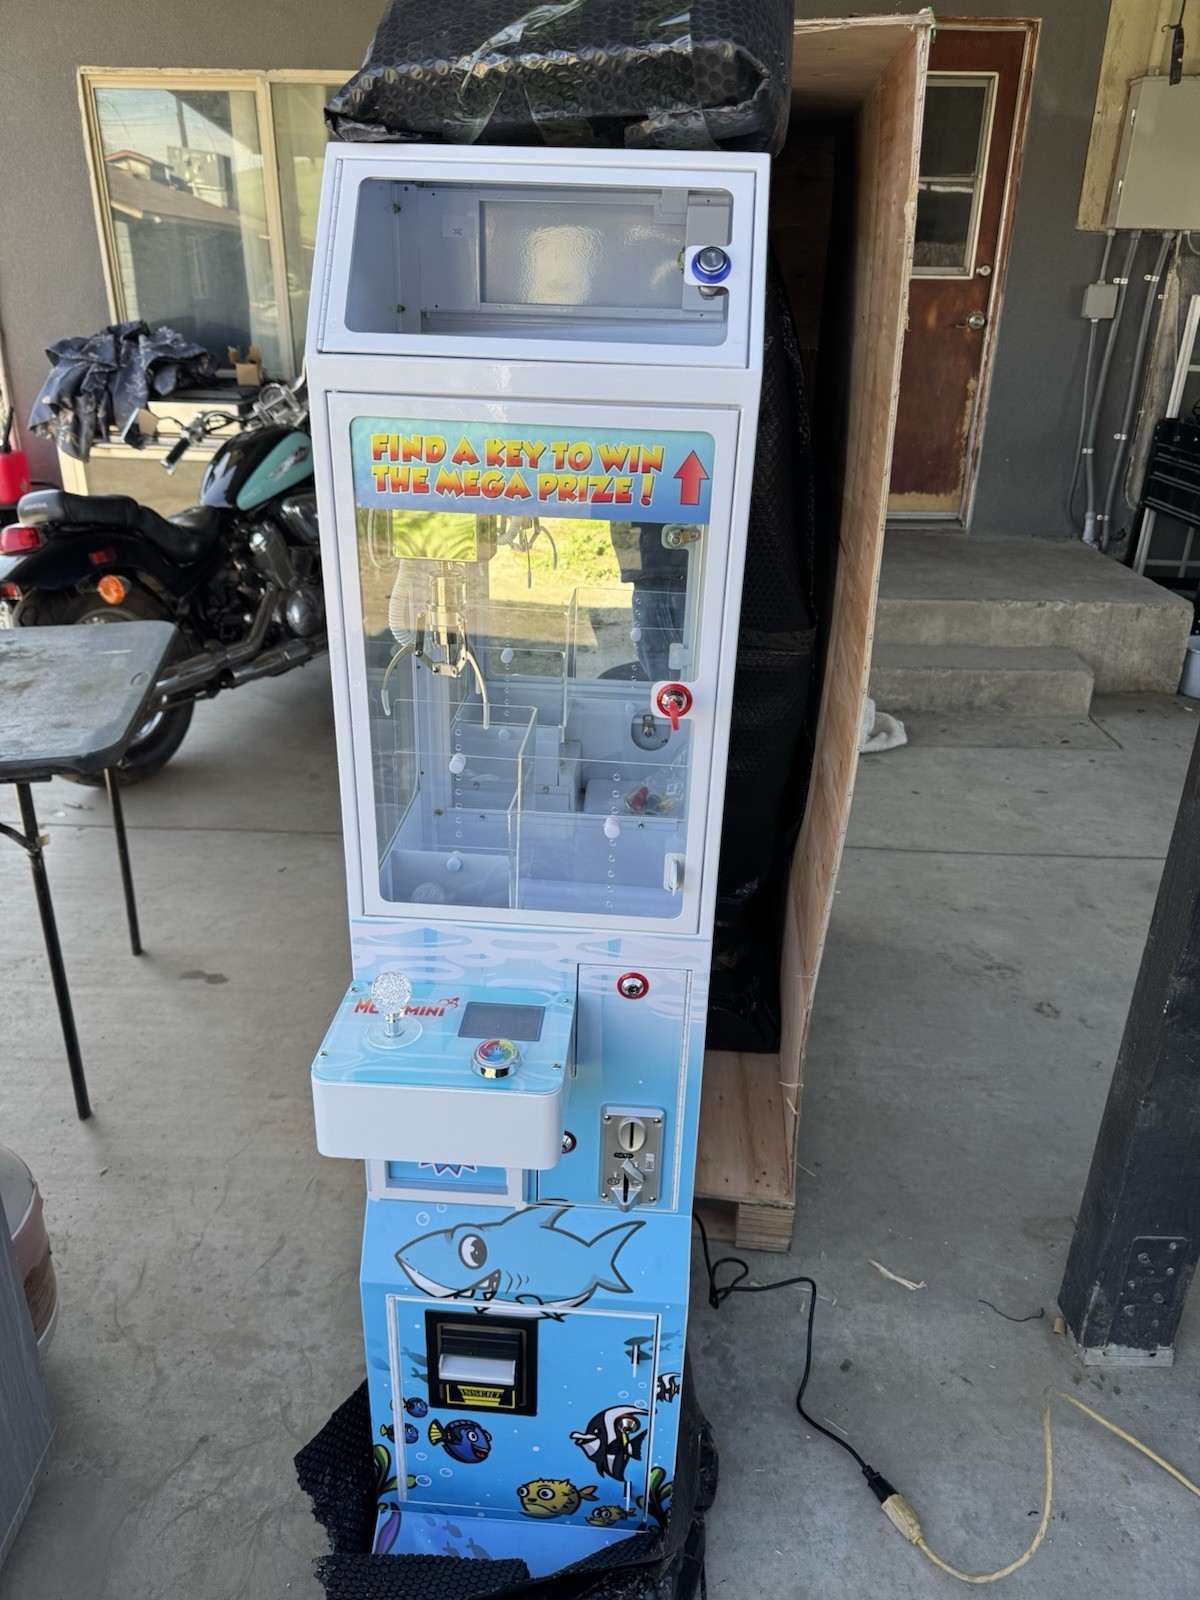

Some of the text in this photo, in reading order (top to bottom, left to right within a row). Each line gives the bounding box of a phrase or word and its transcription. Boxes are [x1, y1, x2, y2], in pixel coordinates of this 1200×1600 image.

[371, 433, 666, 474] FIND A KEY TO WIN
[371, 465, 430, 495] THE
[434, 467, 532, 500] MEGA
[460, 1389, 501, 1398] INSERT
